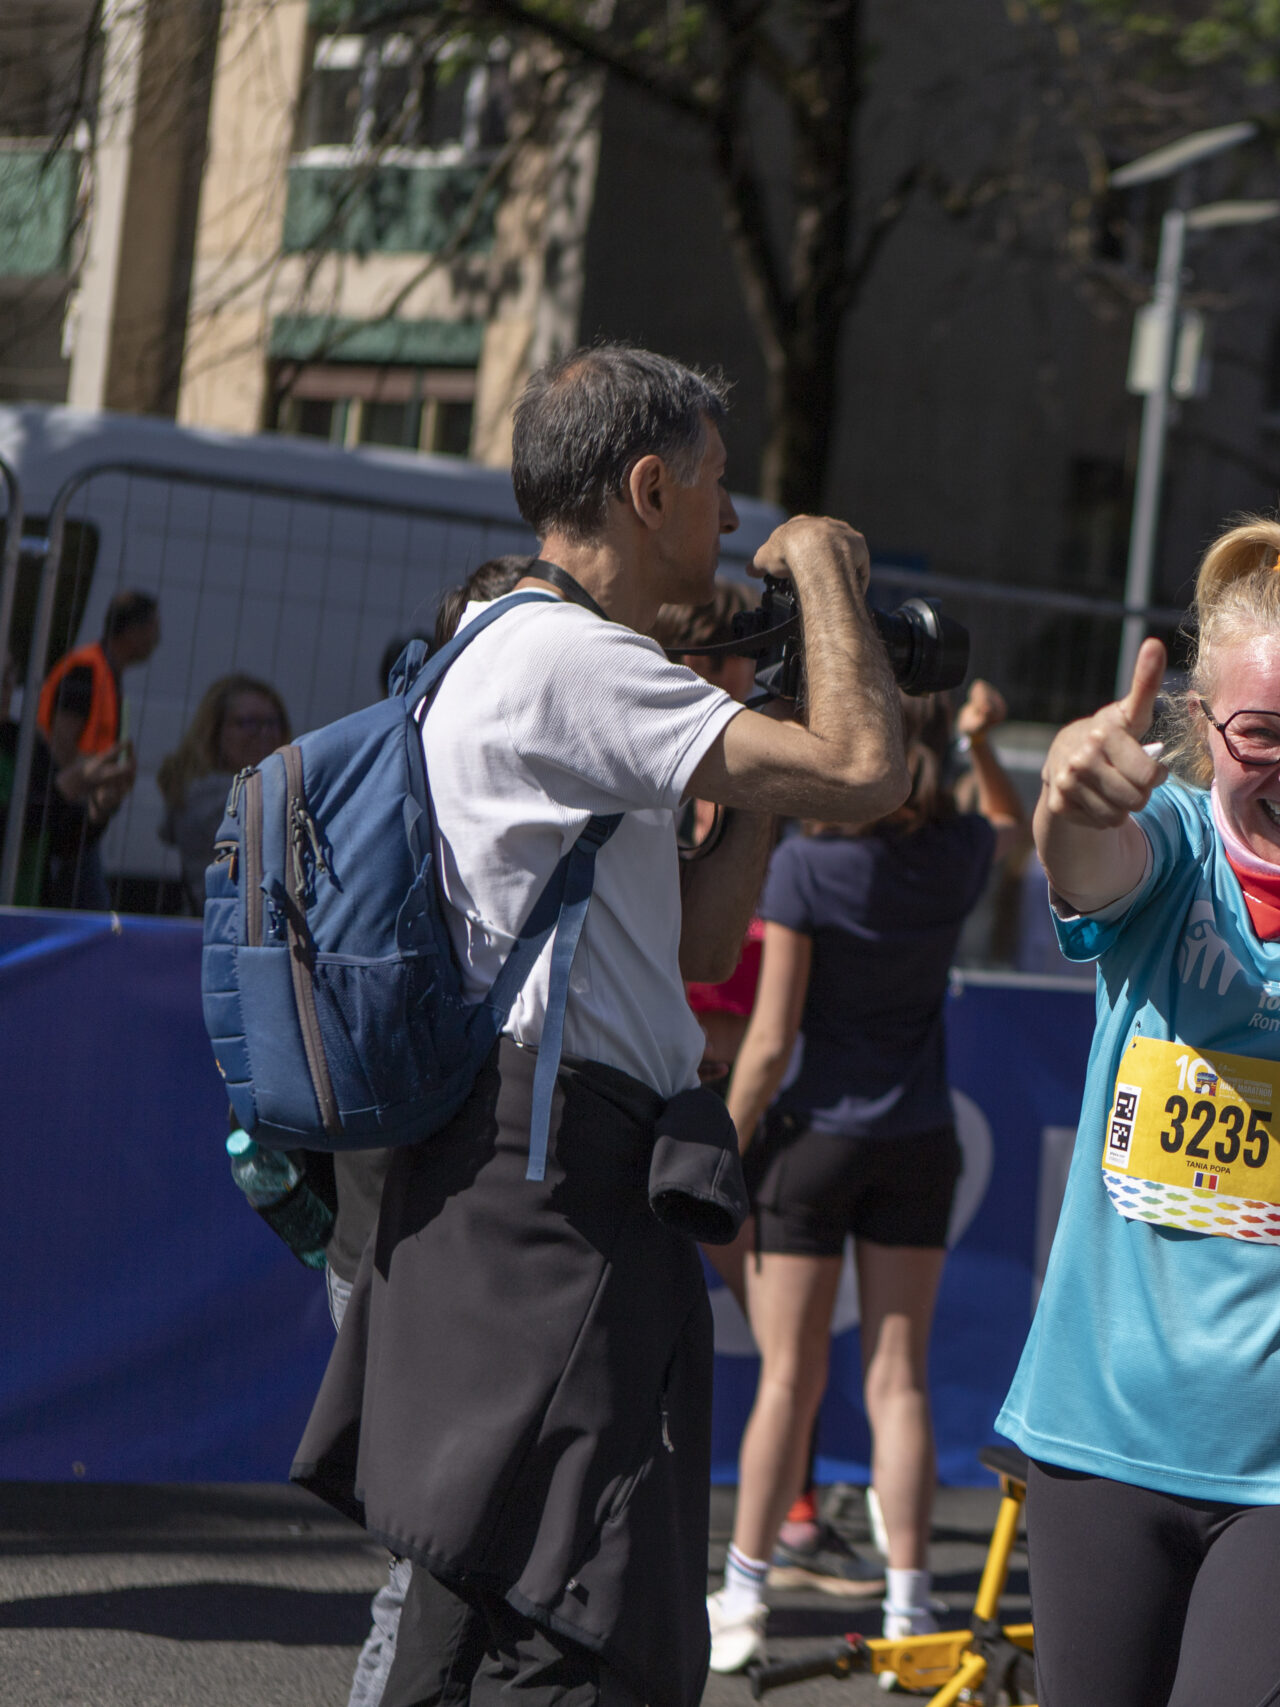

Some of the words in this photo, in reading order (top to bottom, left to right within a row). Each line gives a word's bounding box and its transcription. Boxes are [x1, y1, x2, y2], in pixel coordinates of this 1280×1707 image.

[1160, 1095, 1272, 1168] 3235
[1186, 1160, 1207, 1171] TANIA
[1209, 1163, 1231, 1175] POPA
